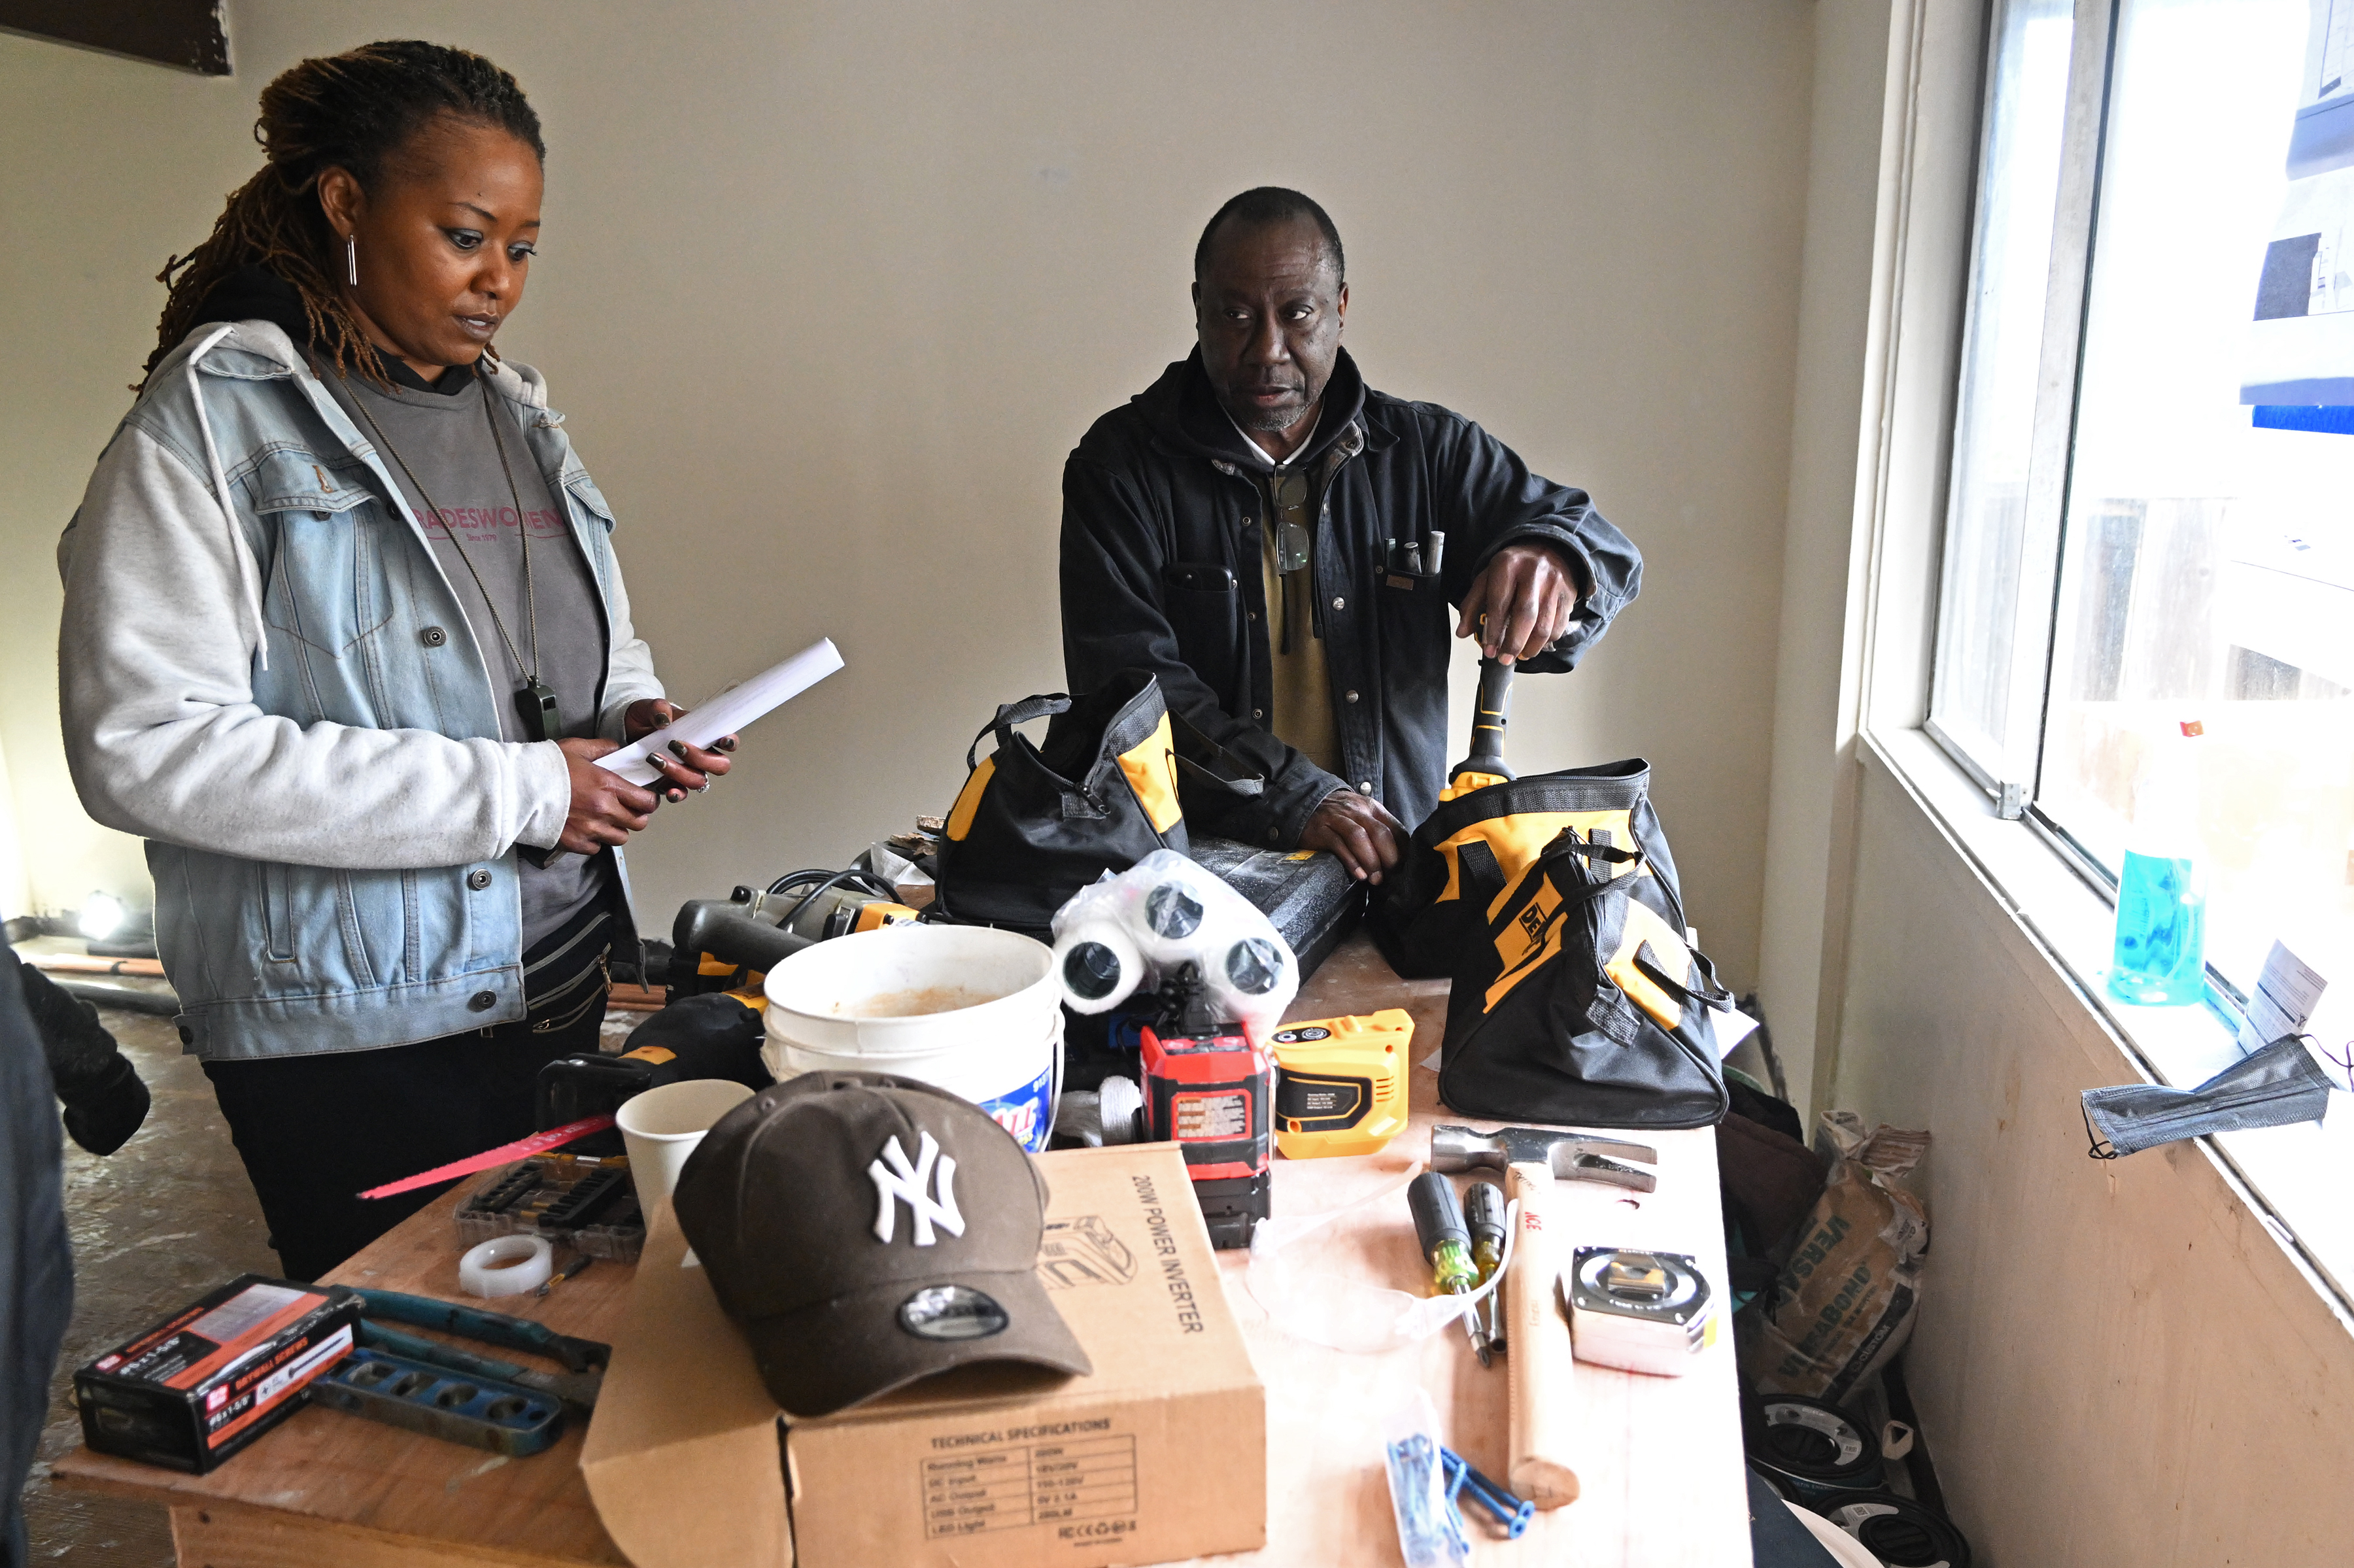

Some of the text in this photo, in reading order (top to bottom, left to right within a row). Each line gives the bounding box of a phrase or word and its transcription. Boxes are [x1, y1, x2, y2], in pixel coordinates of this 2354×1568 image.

[868, 1130, 966, 1247] NY
[1524, 1211, 1542, 1231] ACE
[1132, 1175, 1204, 1334] 200W POWER INVERTER
[931, 1418, 1111, 1449] TECHNICAL SPECIFICATIONS
